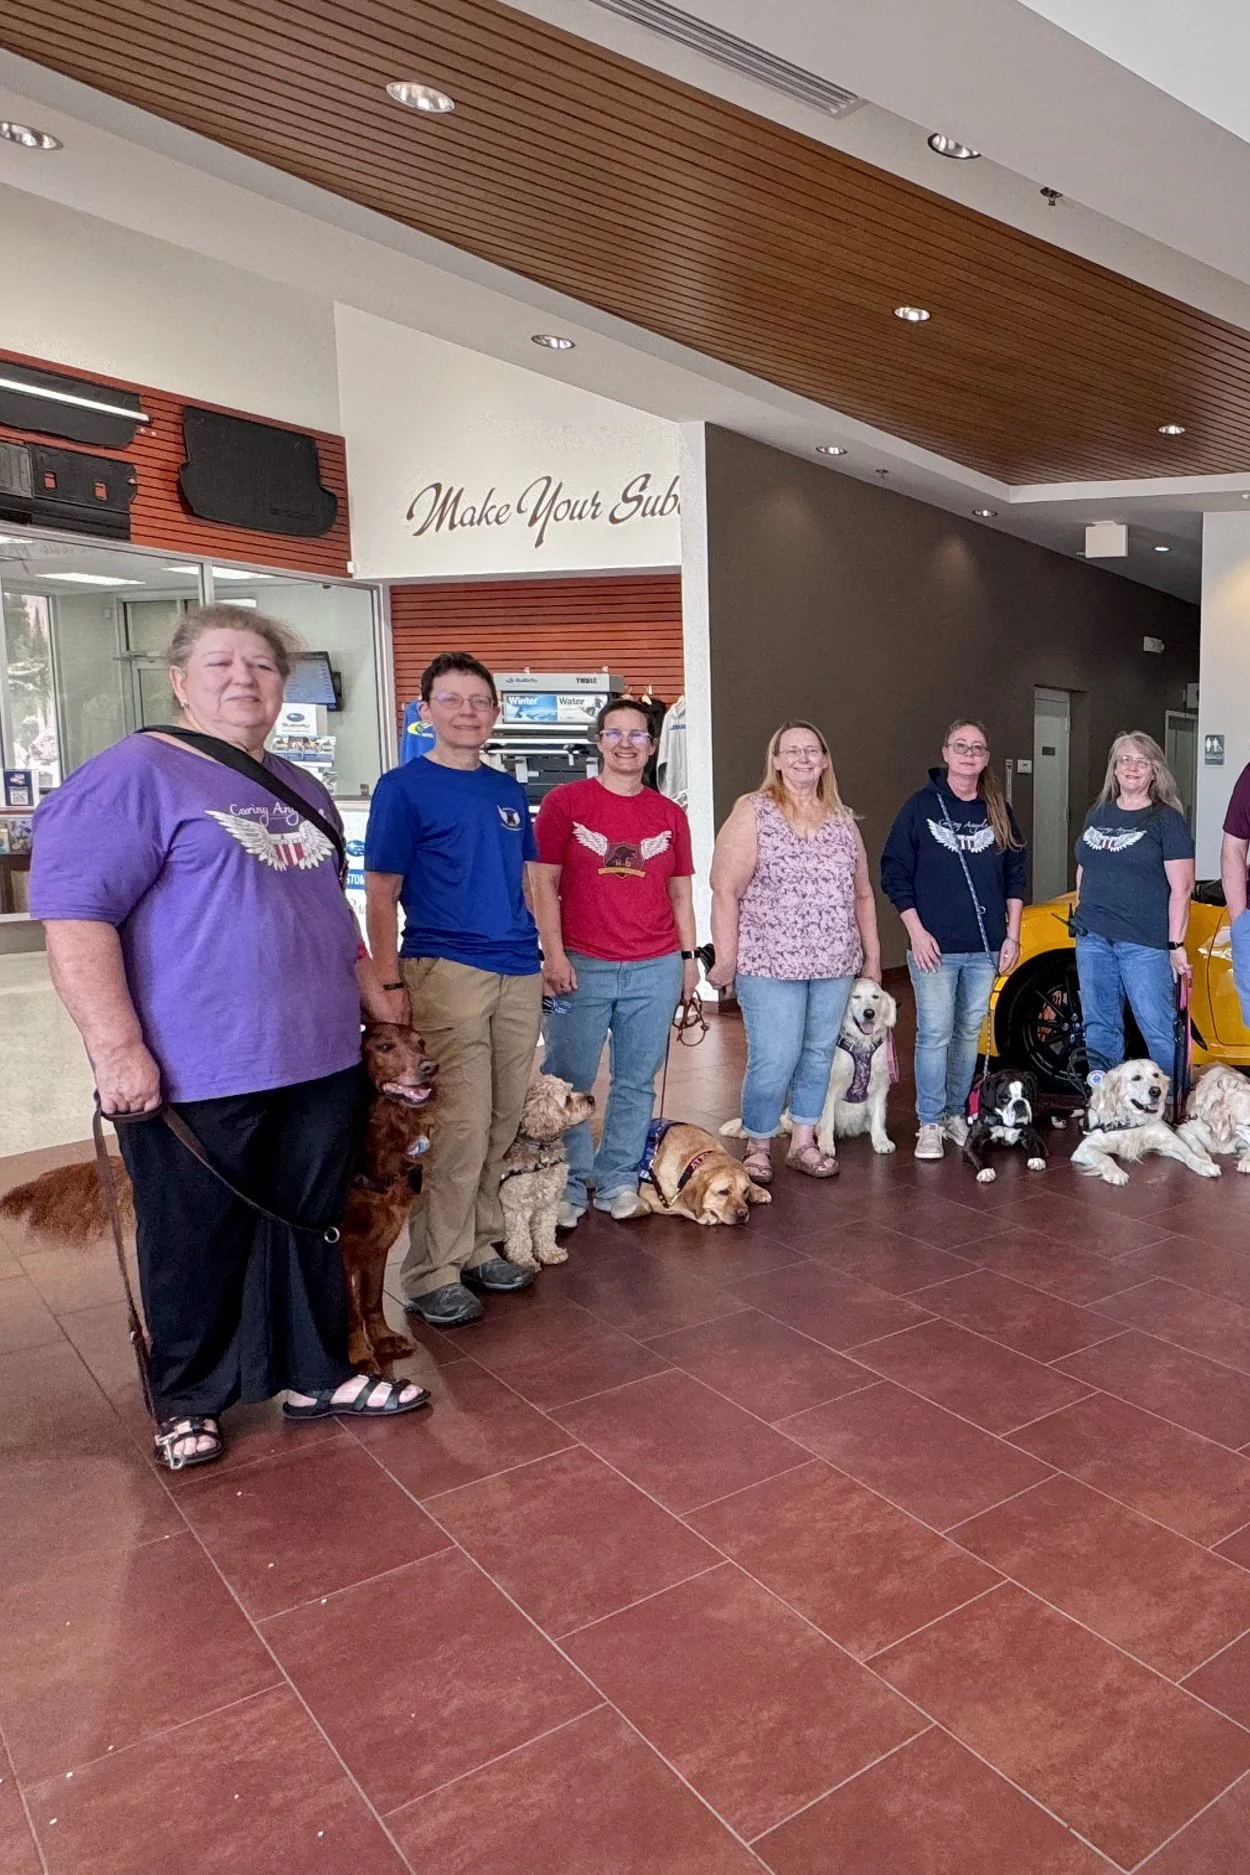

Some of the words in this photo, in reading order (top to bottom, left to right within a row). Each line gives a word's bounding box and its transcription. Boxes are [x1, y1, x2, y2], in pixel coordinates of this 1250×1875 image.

[406, 482, 512, 536] Make
[517, 475, 603, 548] Your
[608, 473, 681, 525] Sub
[508, 696, 538, 705] Winter
[560, 697, 585, 705] Water
[229, 803, 269, 827] Caring
